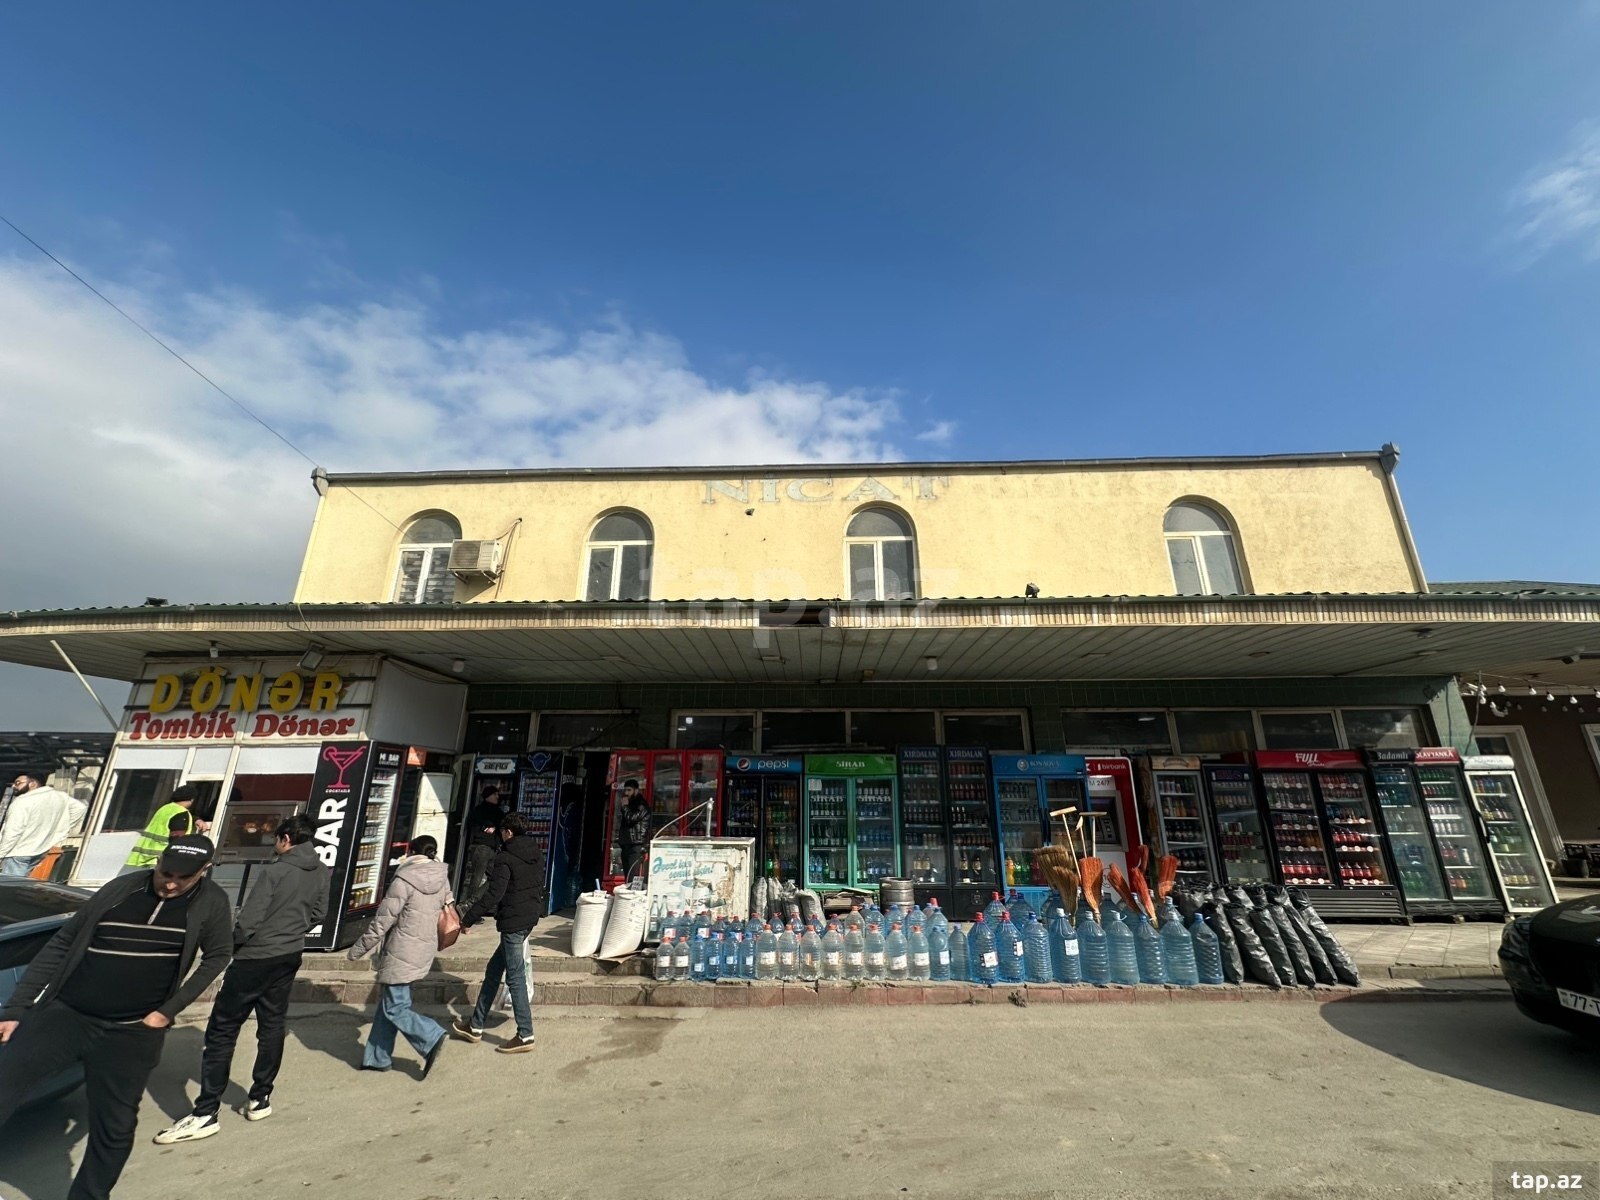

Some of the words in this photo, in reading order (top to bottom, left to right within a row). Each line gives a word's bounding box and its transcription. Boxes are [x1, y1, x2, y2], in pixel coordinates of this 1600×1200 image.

[148, 667, 343, 714] DÖNƏR
[130, 712, 237, 740] Tombik
[251, 714, 355, 737] Dönər
[757, 758, 789, 770] pepsi
[1295, 753, 1320, 763] FULL
[314, 798, 348, 867] BAR
